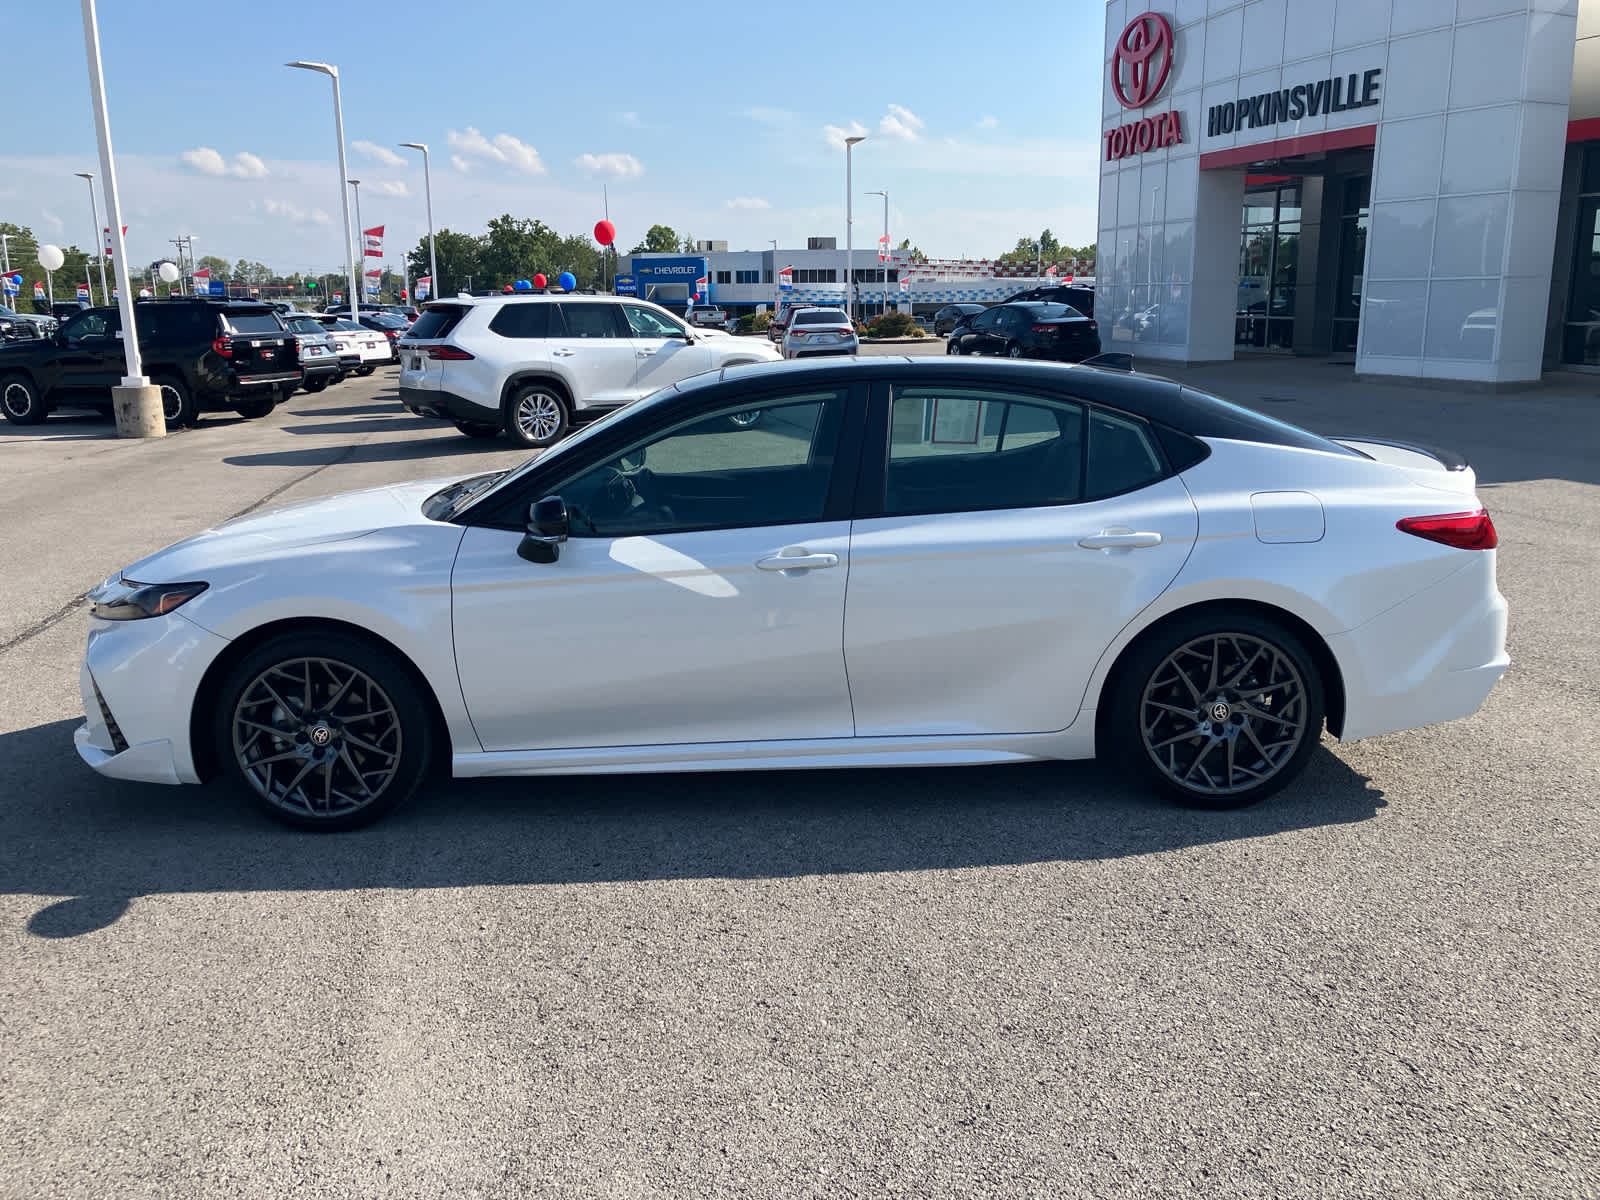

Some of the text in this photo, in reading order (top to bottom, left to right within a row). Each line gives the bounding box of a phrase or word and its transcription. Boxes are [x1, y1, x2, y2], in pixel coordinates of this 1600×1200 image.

[1207, 68, 1381, 137] HOPKINSVILLE
[1104, 110, 1182, 161] TOYOTA
[654, 266, 696, 275] CHEVROLET
